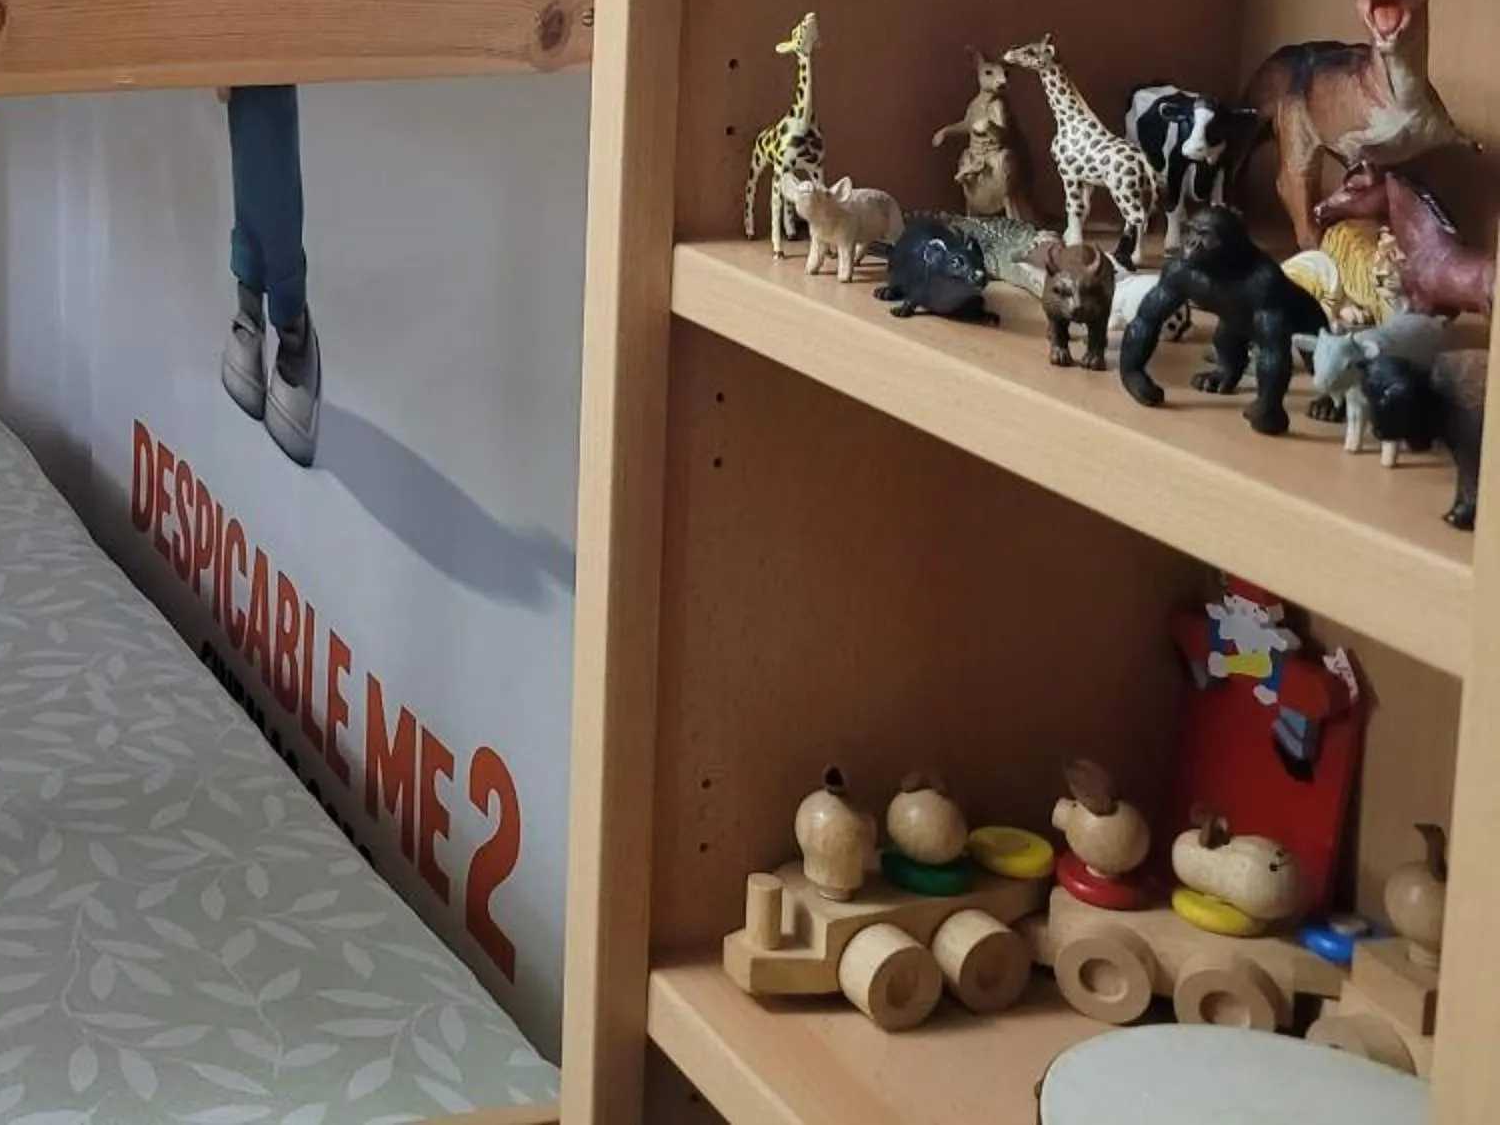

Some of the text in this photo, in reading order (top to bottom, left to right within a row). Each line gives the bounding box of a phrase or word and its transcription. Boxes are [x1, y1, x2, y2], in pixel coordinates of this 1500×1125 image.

[131, 419, 353, 787] DESPICABLE
[366, 671, 455, 906] ME
[466, 745, 522, 984] 2
